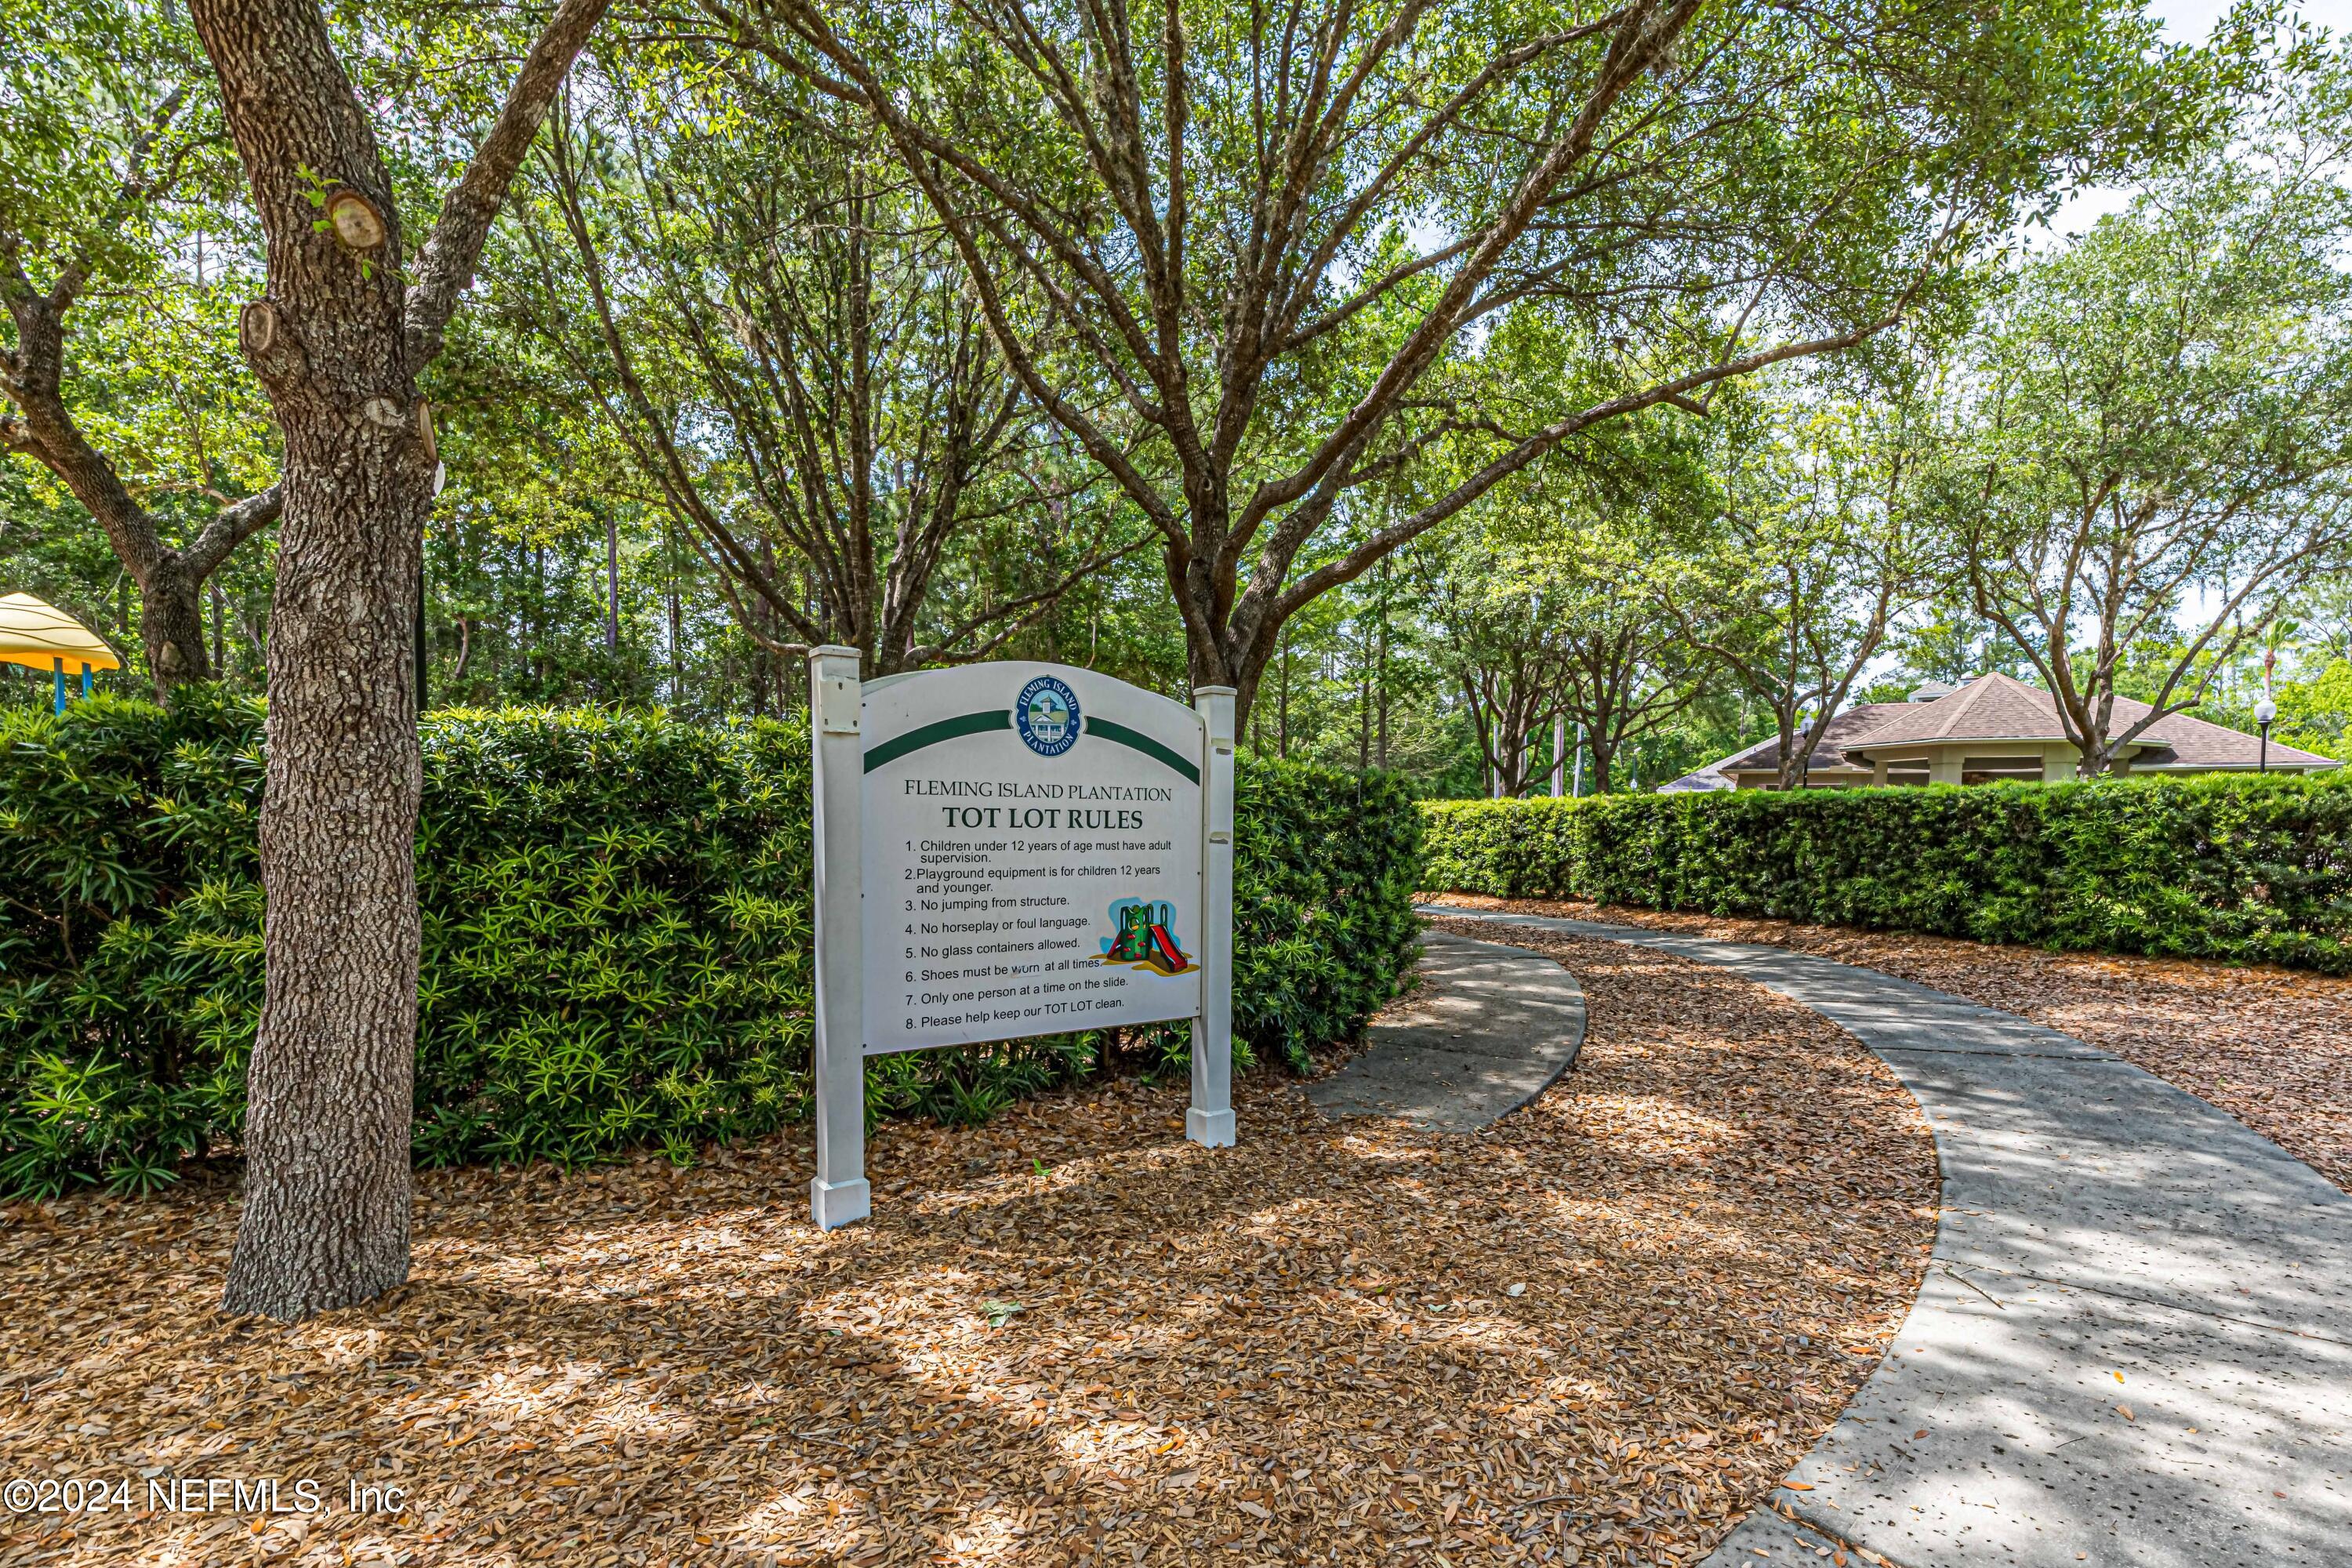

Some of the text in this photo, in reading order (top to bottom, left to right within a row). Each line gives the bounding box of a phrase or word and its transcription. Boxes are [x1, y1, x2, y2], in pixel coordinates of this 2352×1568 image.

[1019, 680, 1077, 710] FLEMING ISLAND
[1023, 731, 1073, 754] PLANTATION
[905, 780, 1171, 801] FLEMING ISLAND PLANTATION
[942, 808, 1142, 829] TOT LOT RULES
[906, 840, 1171, 853] 1. Children under 12 years of age must have adult
[920, 852, 991, 866] supervision.
[988, 867, 1046, 880] equipment
[1050, 866, 1057, 877] is
[1061, 866, 1074, 876] for
[1078, 866, 1116, 876] children
[1120, 866, 1131, 875] 12
[1135, 867, 1160, 877] years
[916, 883, 993, 895] and younger.
[906, 896, 1069, 913] 3. No jumping from structure.
[906, 924, 916, 935] 4.
[921, 924, 938, 934] No
[942, 920, 998, 934] horseplay
[1017, 918, 1036, 928] foul
[1040, 918, 1090, 929] language.
[906, 938, 1080, 959] 5. No glass containers allowed.
[906, 971, 916, 982] 6.
[921, 970, 959, 981] Shoes
[964, 966, 990, 978] must
[995, 965, 1007, 975] be
[1045, 961, 1054, 971] at
[1058, 960, 1069, 970] all
[1073, 960, 1101, 969] times.
[906, 995, 916, 1006] 7.
[921, 993, 949, 1005] Only
[953, 992, 974, 1001] one
[978, 989, 1015, 1001] person
[1020, 985, 1030, 995] at
[1044, 984, 1065, 993] time
[1085, 979, 1100, 989] the
[1103, 977, 1127, 987] slide.
[906, 999, 1123, 1029] 8. Please help keep our TOT LOT clean.
